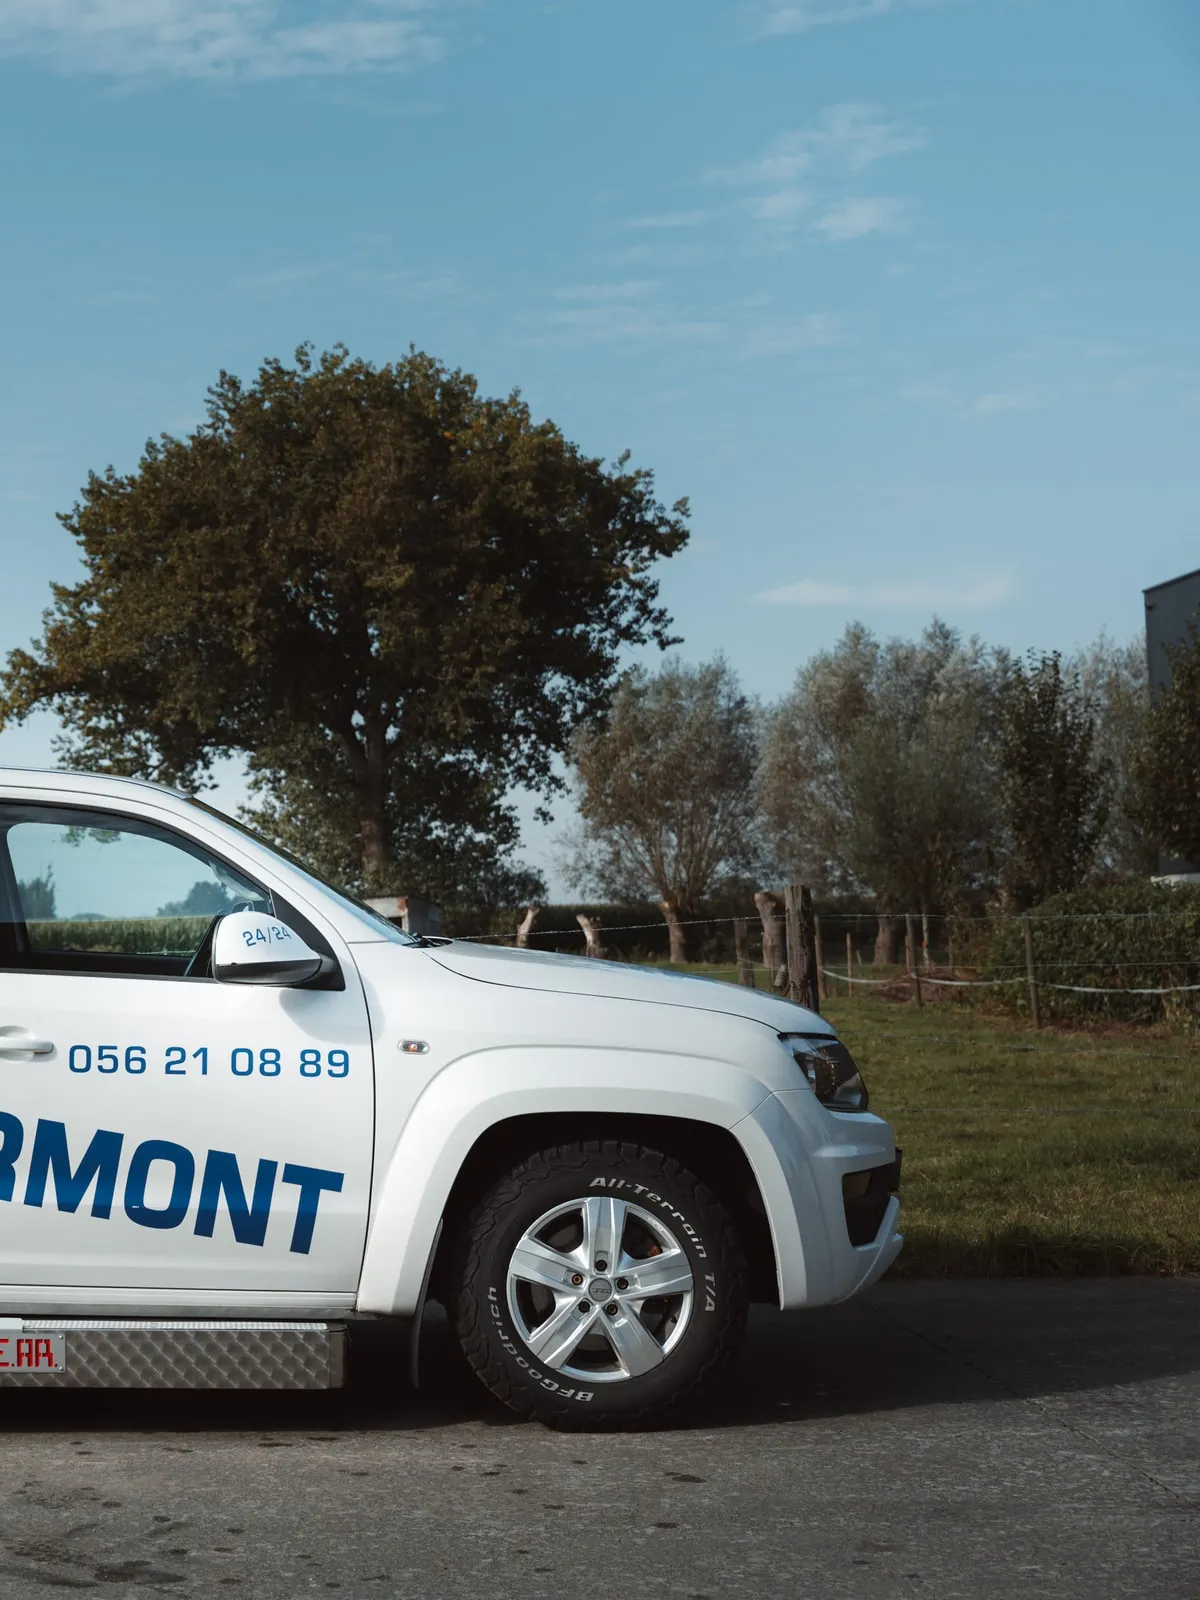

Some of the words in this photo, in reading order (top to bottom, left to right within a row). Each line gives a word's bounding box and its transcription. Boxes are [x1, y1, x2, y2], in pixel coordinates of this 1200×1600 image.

[242, 926, 292, 947] 24/24
[69, 1044, 147, 1075] 056
[164, 1046, 209, 1076] 21
[230, 1047, 282, 1078] 08
[299, 1049, 350, 1079] 89
[588, 1176, 708, 1259] All-Terrain
[704, 1271, 718, 1313] T/A
[487, 1286, 595, 1402] BFGoodrich
